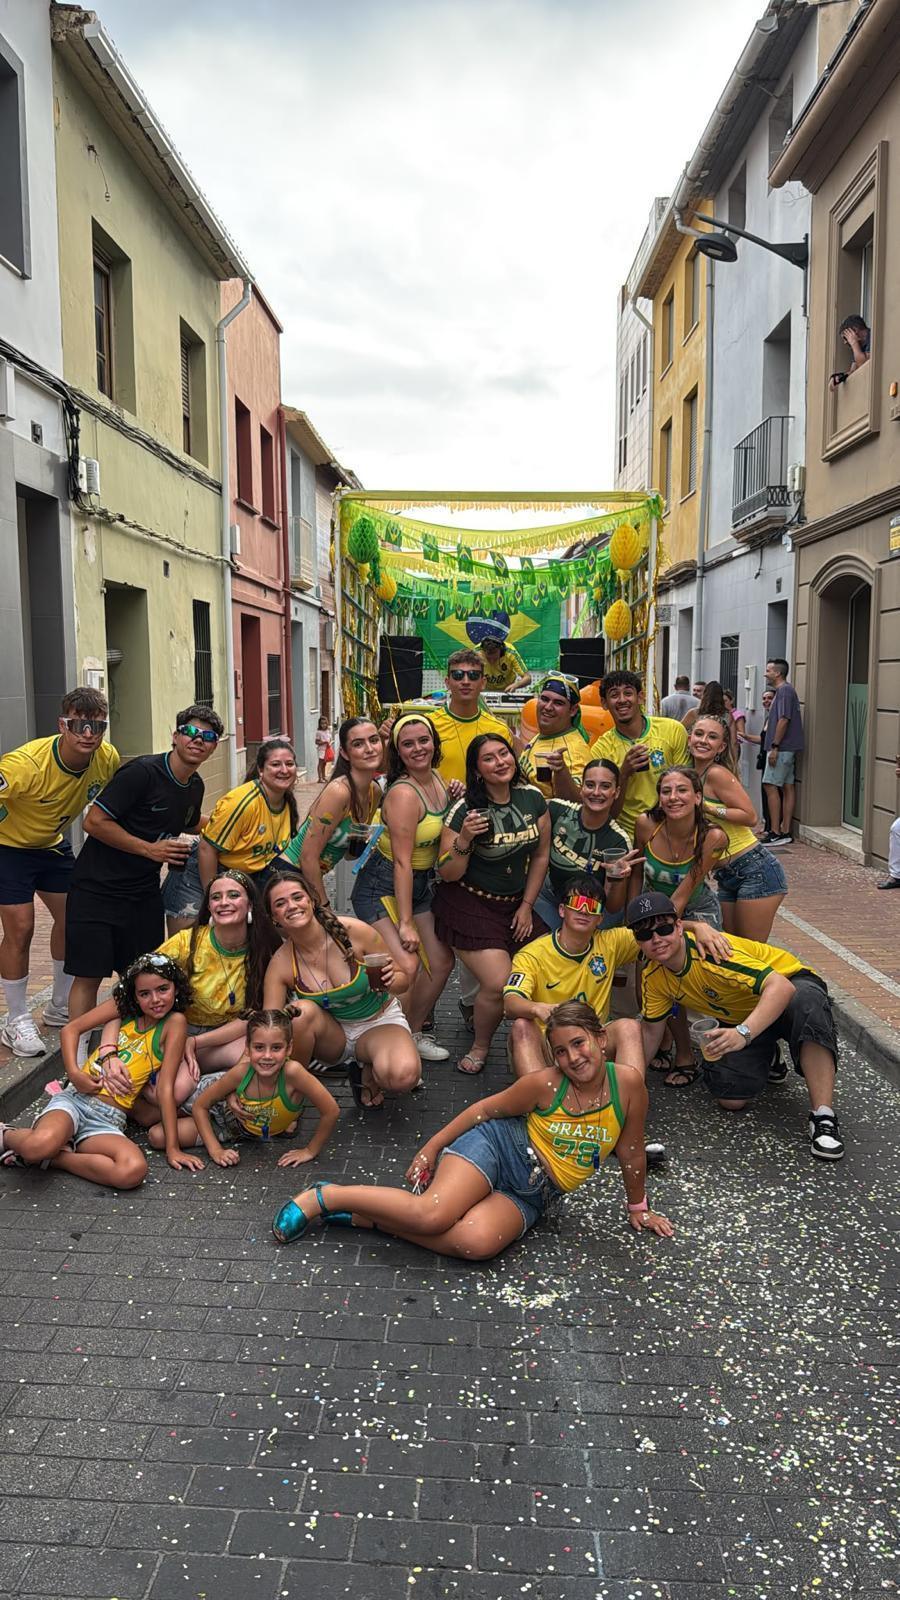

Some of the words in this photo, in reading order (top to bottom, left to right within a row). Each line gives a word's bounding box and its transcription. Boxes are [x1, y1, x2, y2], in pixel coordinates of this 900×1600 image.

[490, 823, 539, 845] razil
[547, 1122, 612, 1142] BRAZIL
[553, 1136, 601, 1169] 78
